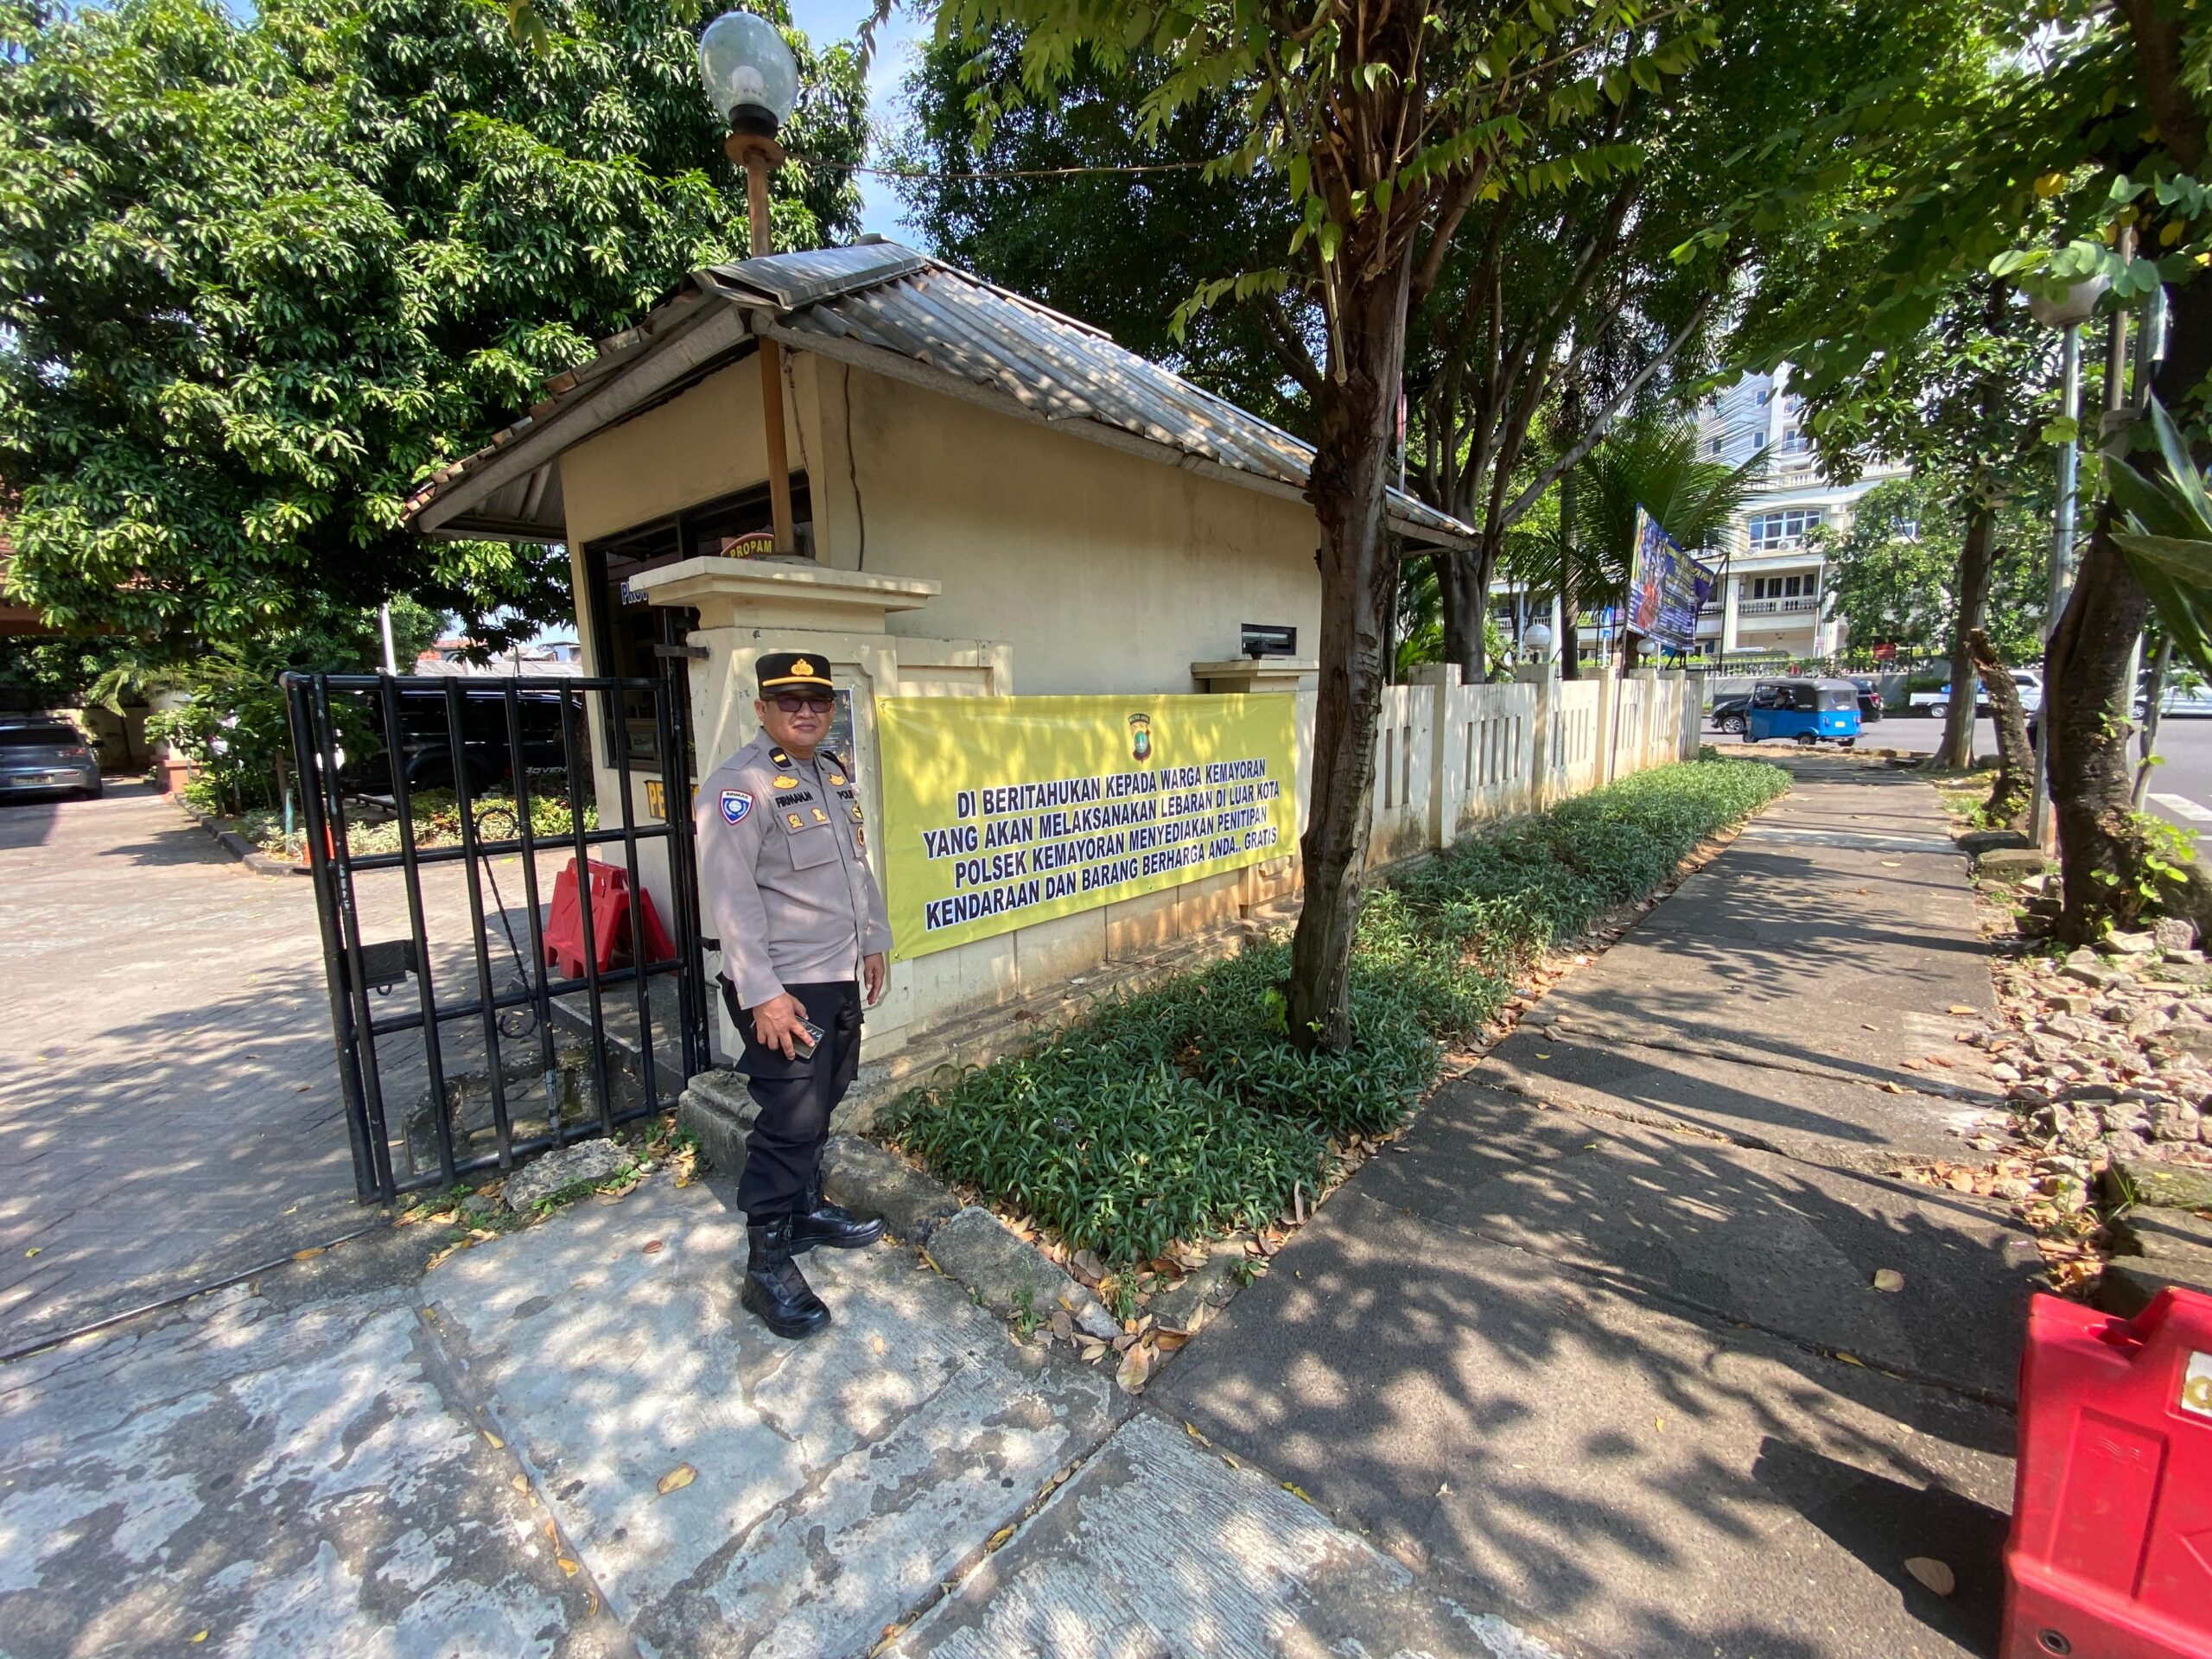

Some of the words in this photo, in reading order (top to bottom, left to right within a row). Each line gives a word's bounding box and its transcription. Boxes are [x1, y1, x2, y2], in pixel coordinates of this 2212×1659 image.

[730, 539, 772, 558] PROPAM
[923, 825, 978, 859] YANG
[984, 817, 1033, 849] AKAN
[1039, 798, 1157, 839] MELAKSANAKAN
[1160, 789, 1212, 817] LEBARAN
[1216, 788, 1226, 808] DI
[1230, 785, 1254, 806] LUAR
[1256, 780, 1280, 800] KOTA
[957, 791, 976, 818] DI
[982, 777, 1101, 815] BERITAHUKAN
[1105, 771, 1157, 798] KEPADA
[1160, 766, 1201, 791] WARGA
[1205, 759, 1266, 784] KEMAYORAN
[926, 879, 1039, 931] KENDARAAN
[1046, 871, 1076, 900] DAN
[1082, 858, 1138, 892] BARANG
[1142, 842, 1205, 876] BERHARGA
[1208, 836, 1241, 860] ANDA..
[1244, 826, 1277, 850] GRATIS
[955, 850, 1027, 888] POLSEK
[1033, 832, 1124, 872] KEMAYORAN
[1129, 816, 1214, 852] MENYEDIAKAN
[1217, 805, 1267, 833] PENITIPAN
